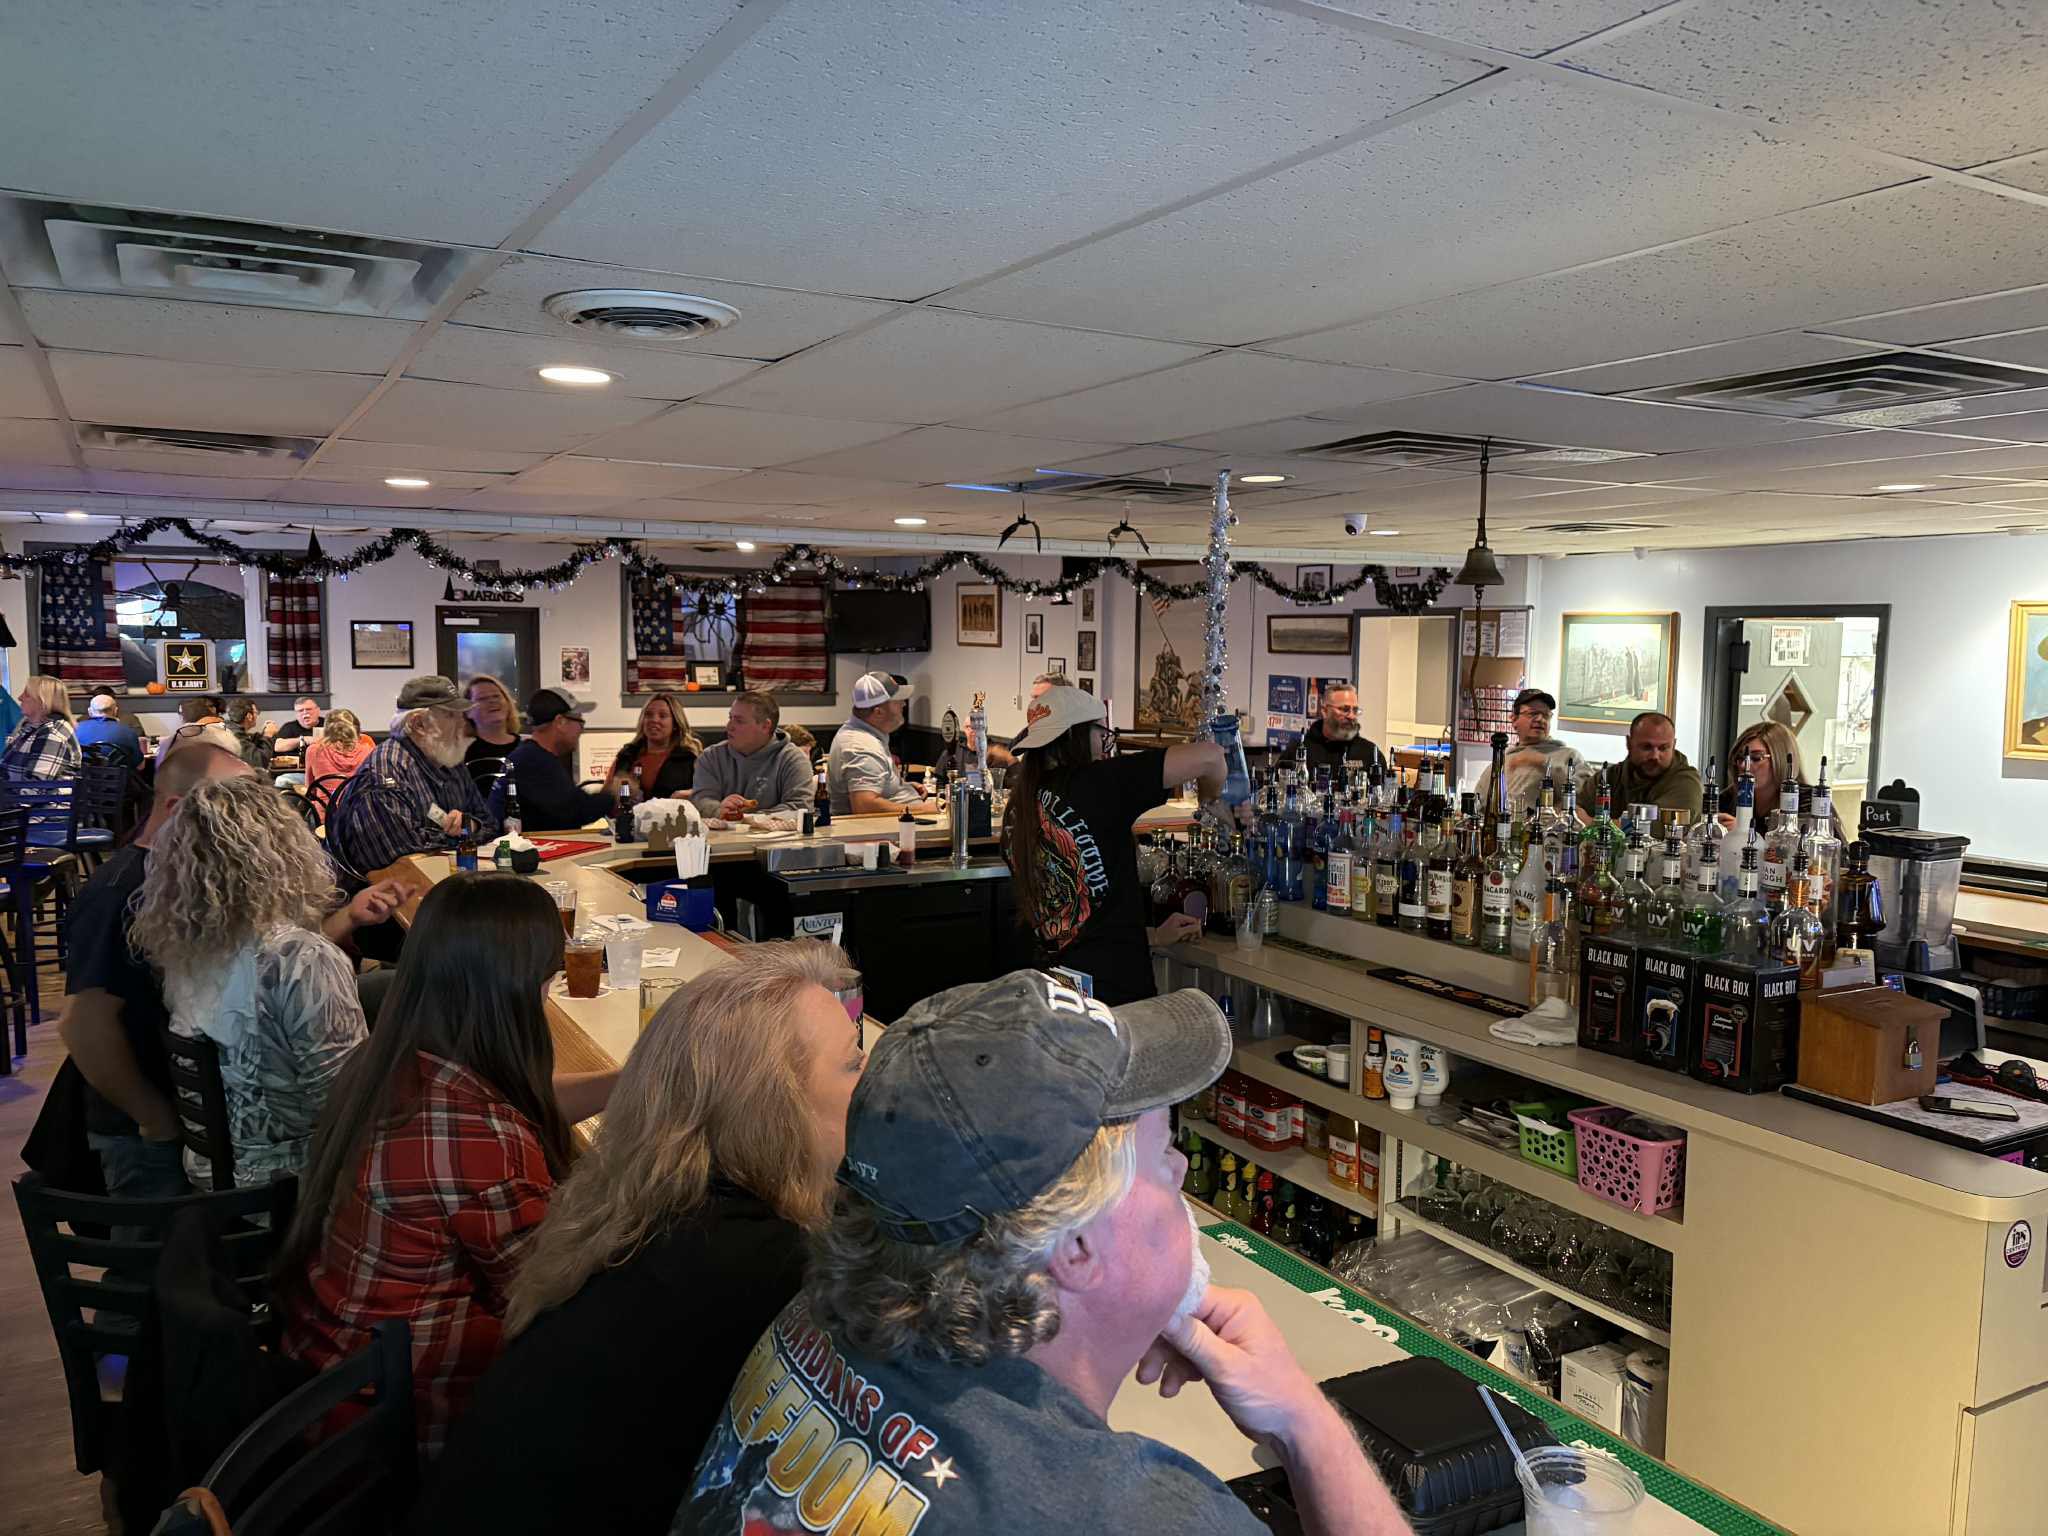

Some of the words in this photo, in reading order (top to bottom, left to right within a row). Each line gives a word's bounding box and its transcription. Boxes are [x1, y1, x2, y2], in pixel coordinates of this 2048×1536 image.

[463, 590, 525, 603] MARINES
[1866, 805, 1891, 822] Post
[1647, 912, 1669, 927] UV
[1682, 921, 1704, 936] UV
[1588, 947, 1612, 965] BLACK
[1613, 952, 1628, 969] BOX
[1645, 957, 1668, 975] BLACK
[1670, 962, 1685, 980] BOX
[1704, 973, 1730, 993] BLACK
[1732, 979, 1749, 997] BOX
[1764, 982, 1784, 999] BLACK
[1784, 980, 1797, 996] BOX
[730, 1324, 931, 1536] EEDOM
[879, 1411, 939, 1469] OF
